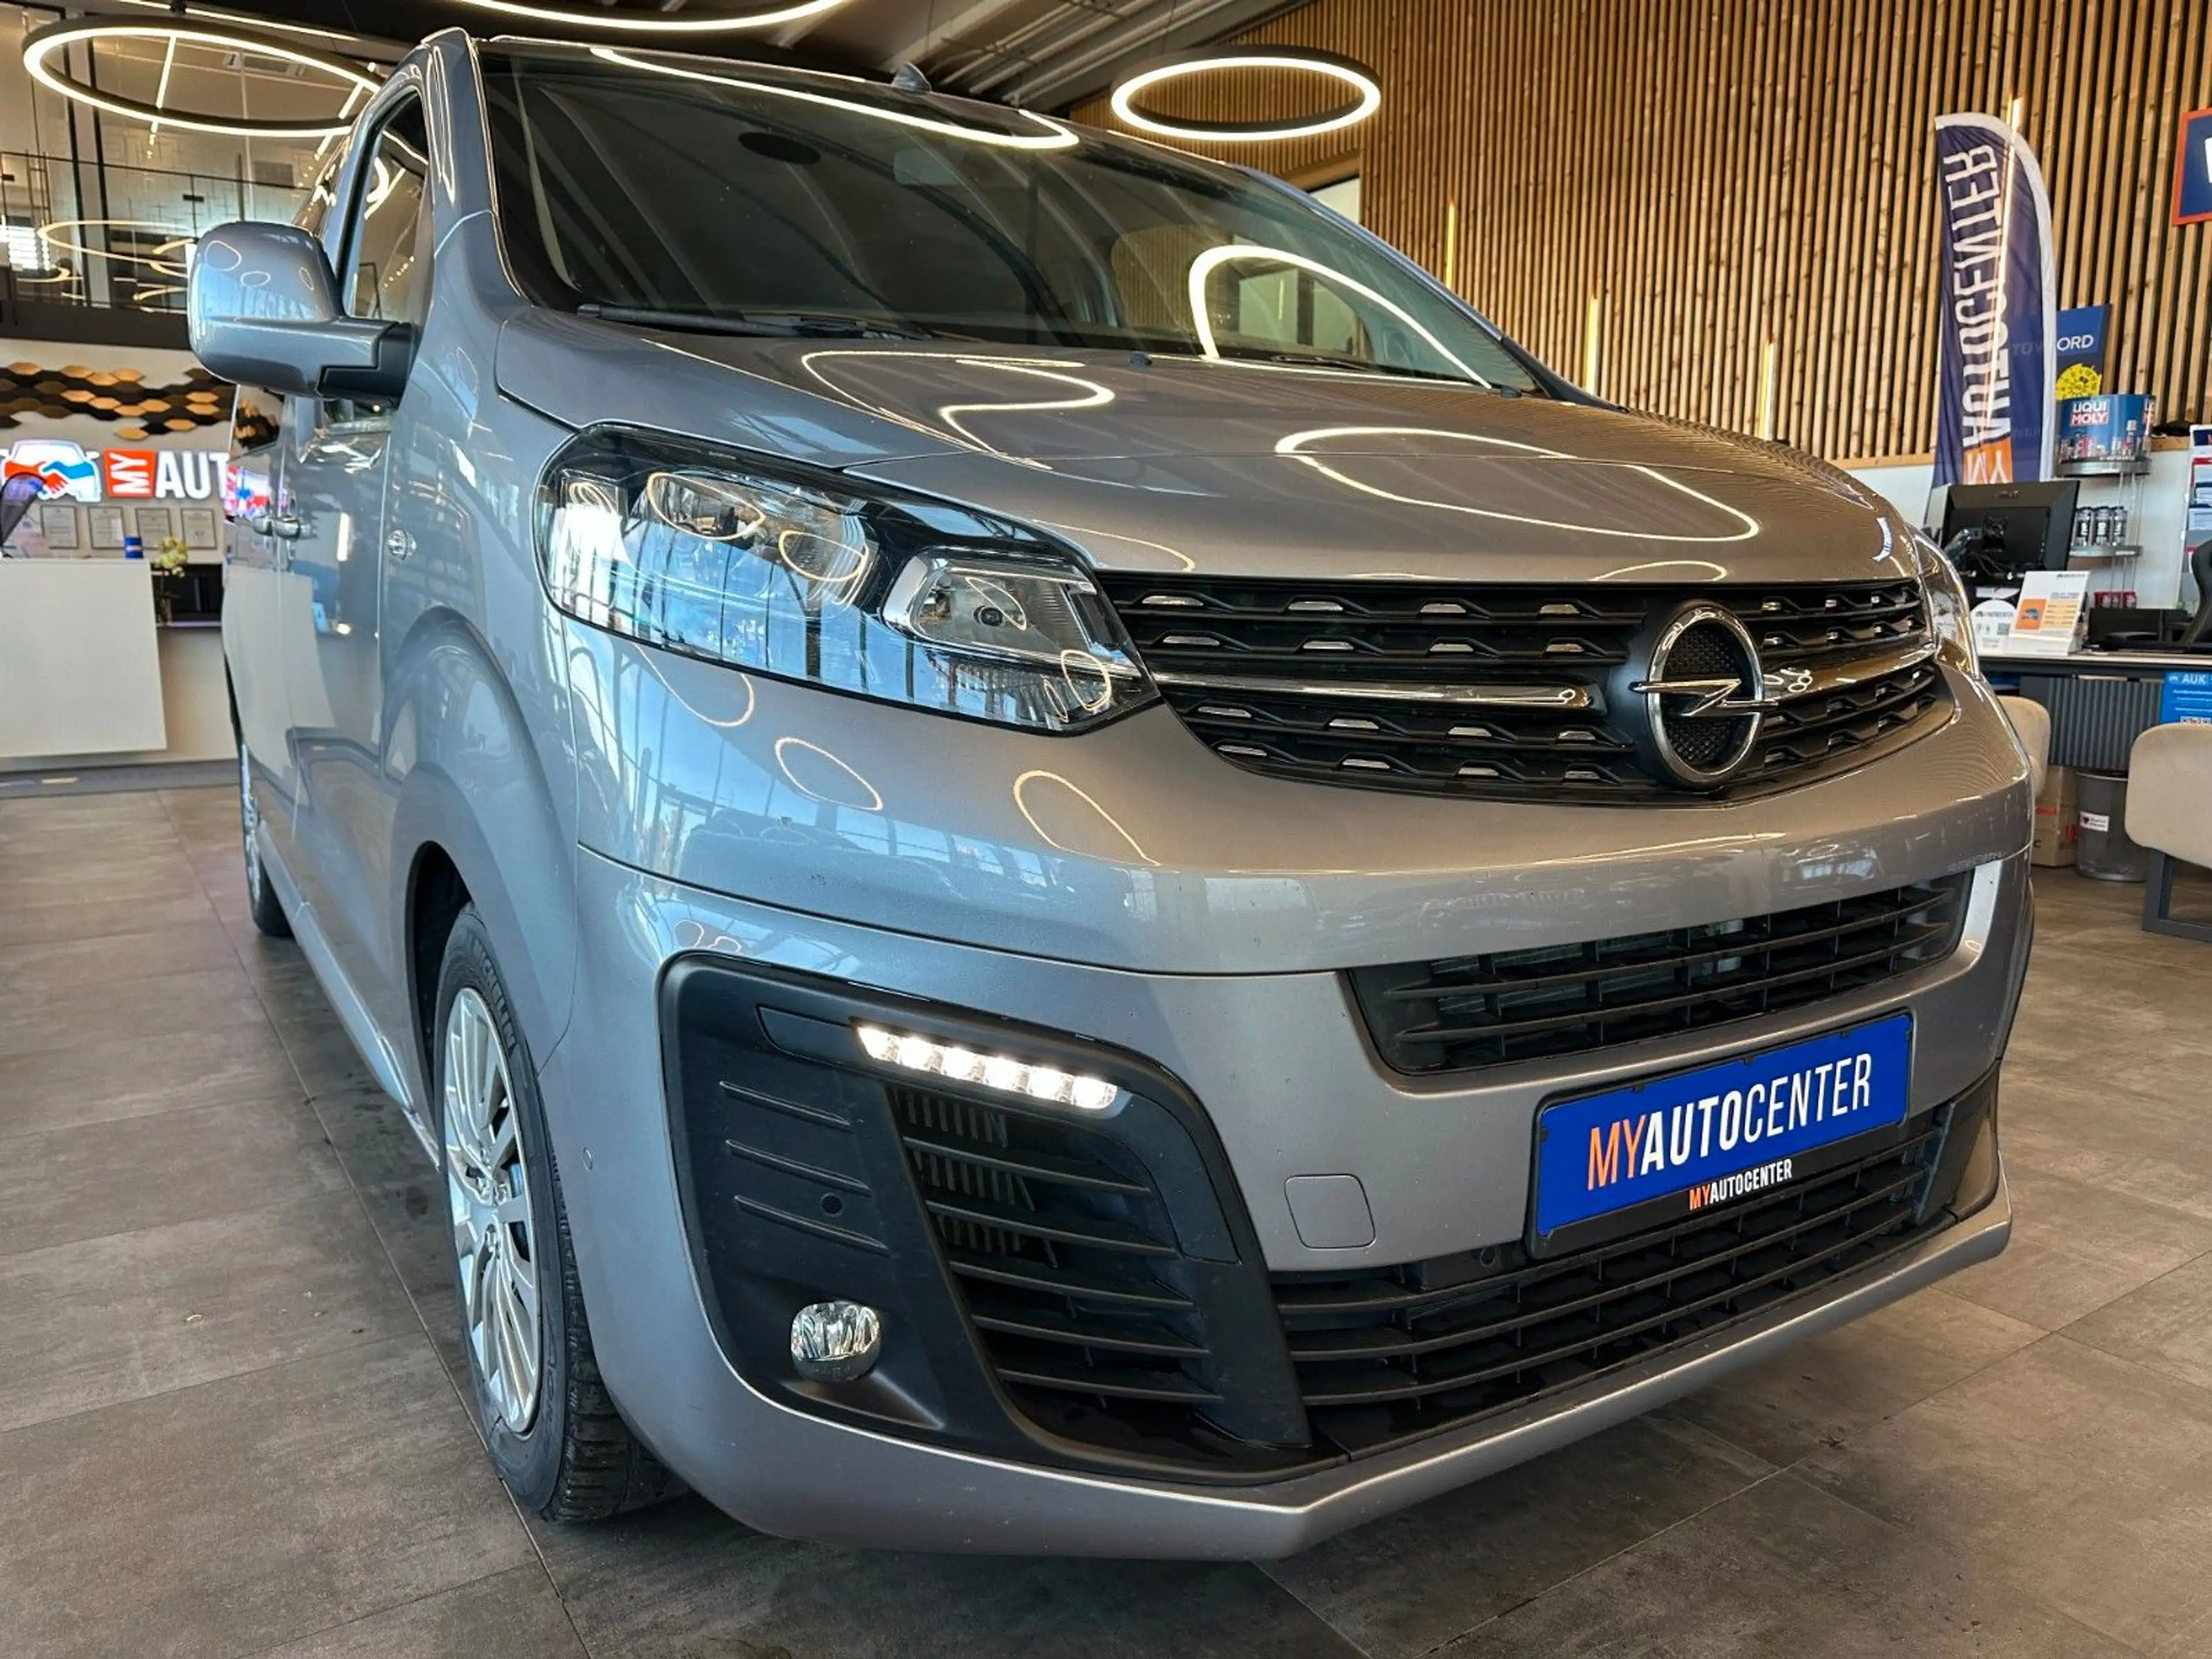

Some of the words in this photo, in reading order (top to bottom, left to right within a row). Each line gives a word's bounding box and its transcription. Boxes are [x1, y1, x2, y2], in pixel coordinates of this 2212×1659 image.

[2056, 334, 2094, 351] ORD
[2070, 411, 2109, 426] MOLY
[2073, 400, 2108, 413] LIQUI
[109, 452, 151, 495] MY
[1588, 1053, 1871, 1191] MYAUTOCENTER
[1689, 1158, 1793, 1211] MYAUTOCENTER
